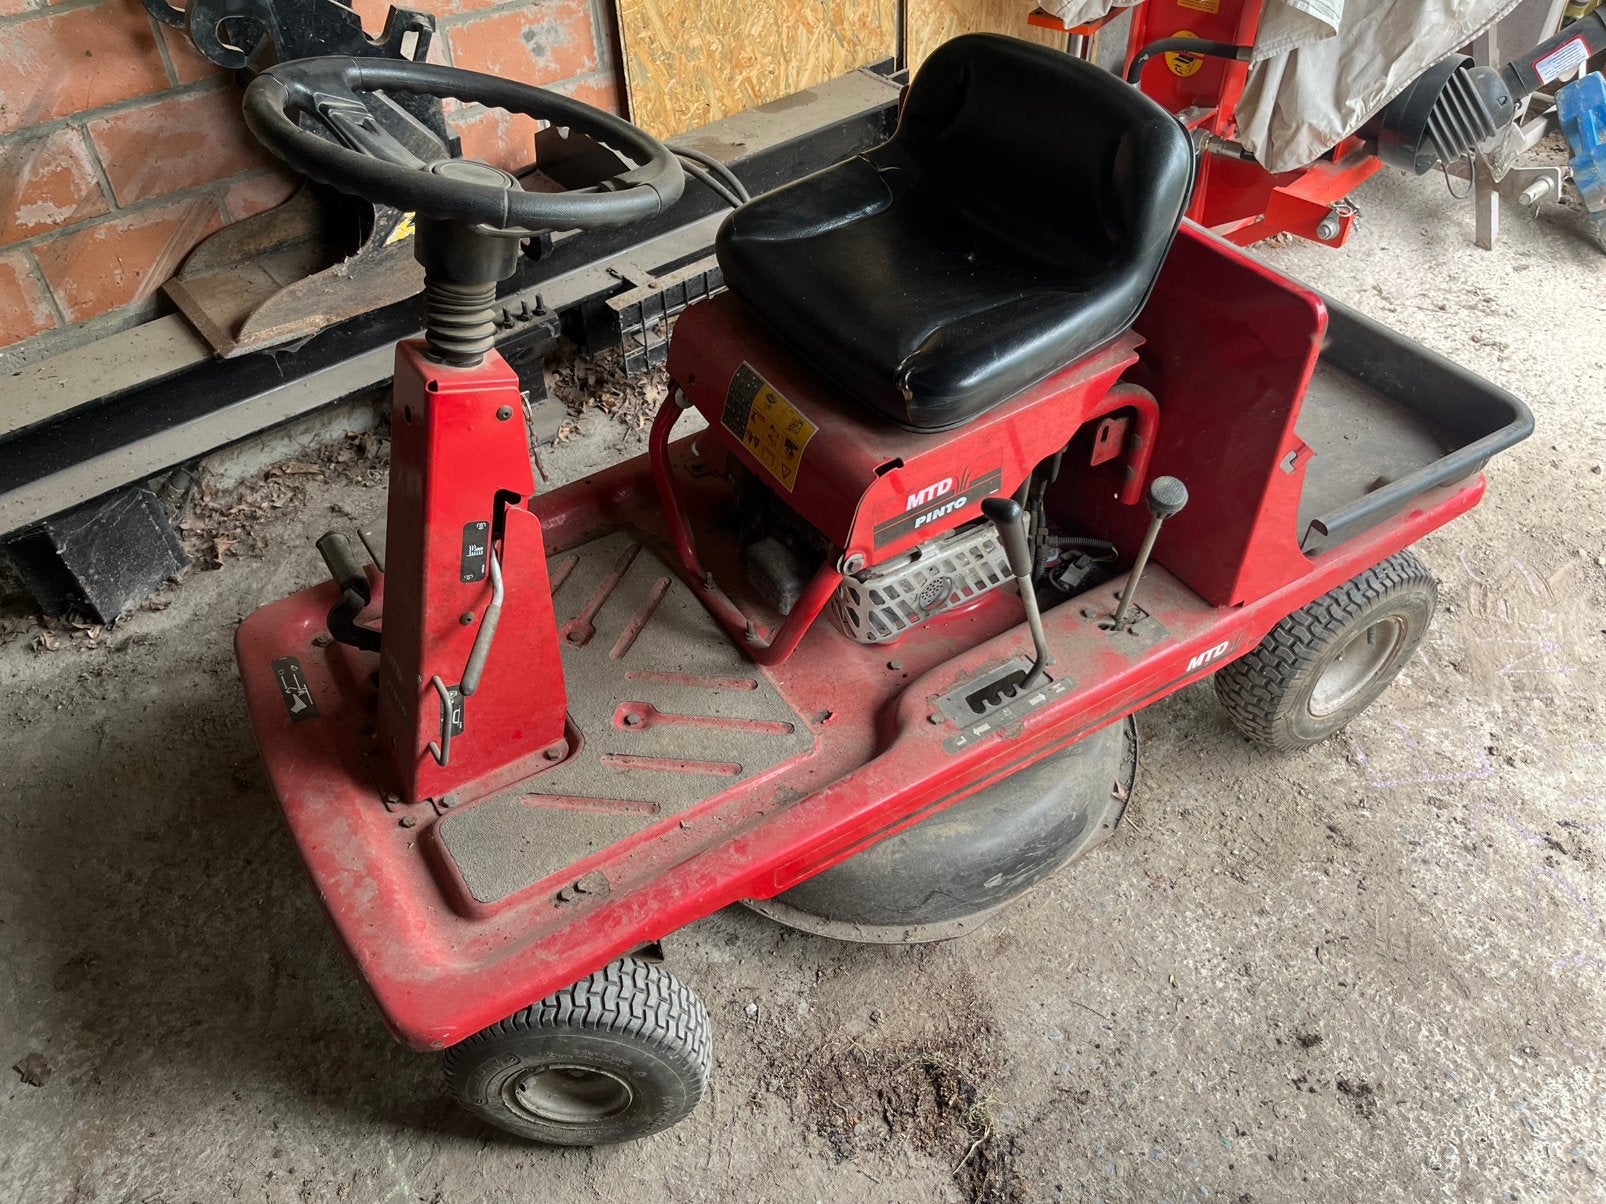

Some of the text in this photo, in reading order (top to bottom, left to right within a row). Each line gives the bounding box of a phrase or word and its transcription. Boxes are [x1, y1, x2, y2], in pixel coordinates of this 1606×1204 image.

[906, 477, 953, 511] MTD
[914, 496, 967, 528] PINTO
[1186, 641, 1229, 672] MTD
